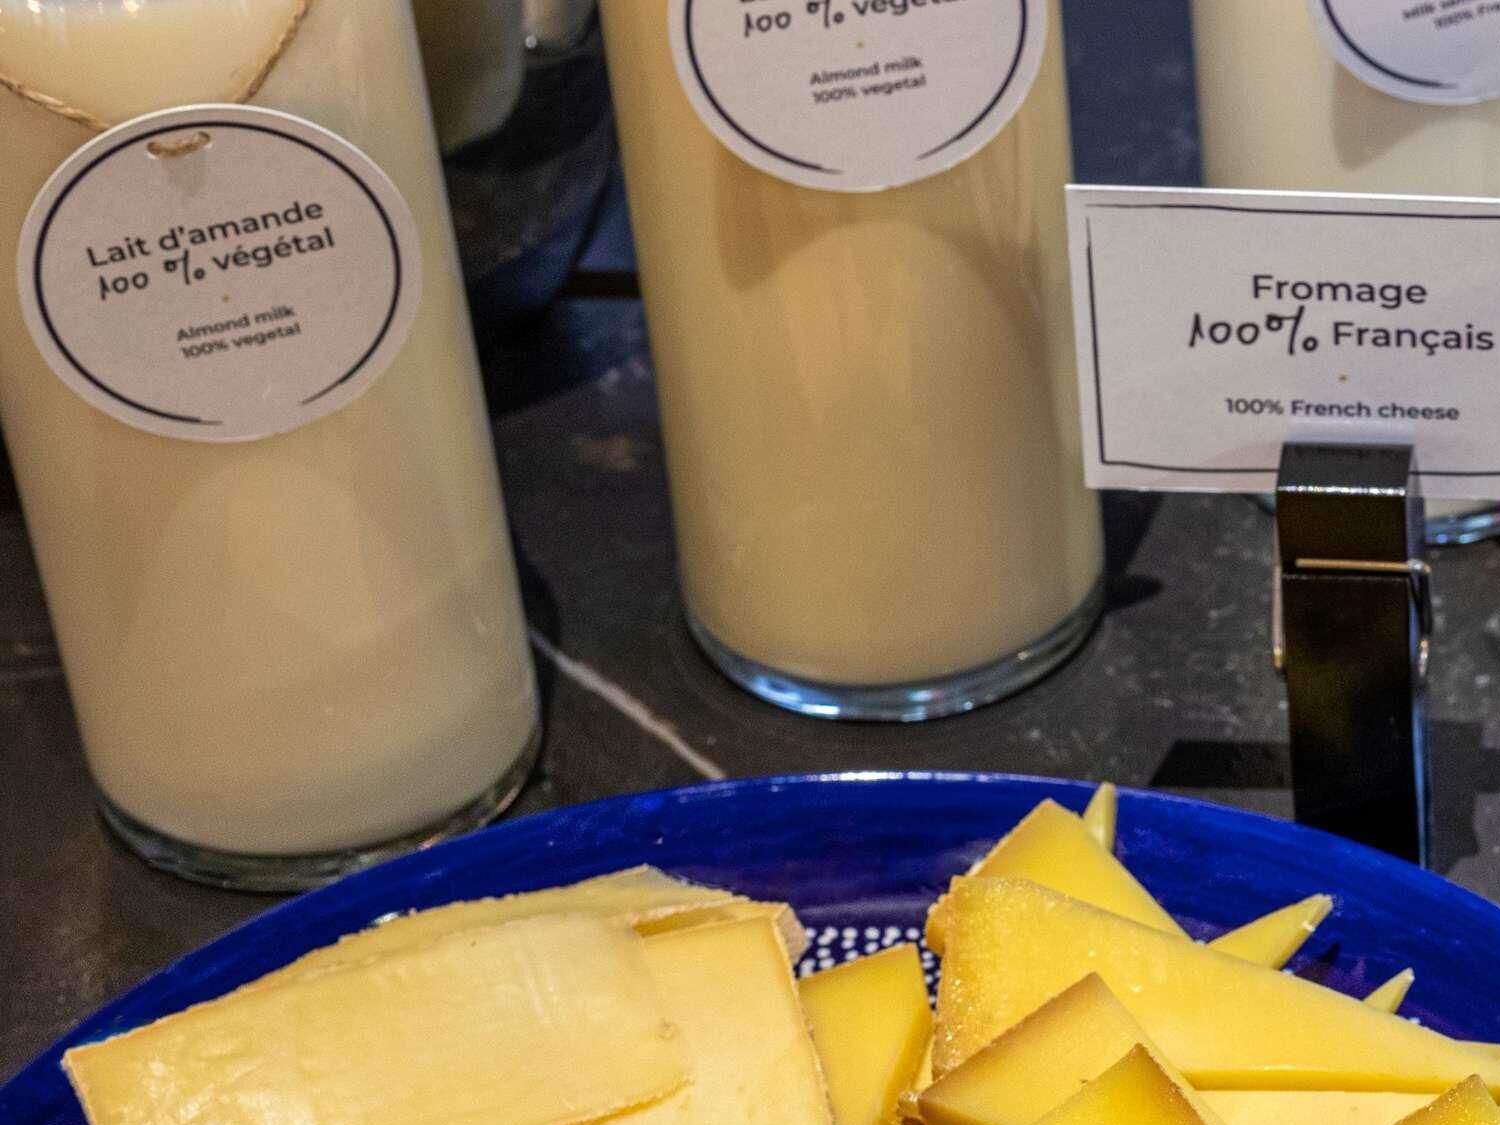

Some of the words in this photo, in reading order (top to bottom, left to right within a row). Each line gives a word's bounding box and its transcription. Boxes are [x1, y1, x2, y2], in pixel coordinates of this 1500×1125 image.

[744, 12, 792, 38] 100
[810, 63, 881, 85] Almond
[884, 56, 923, 72] milk
[813, 86, 857, 103] 100%
[861, 74, 926, 95] vegetal
[87, 227, 150, 267] Lait
[158, 201, 324, 251] d'amande
[99, 270, 150, 301] 100
[212, 226, 335, 269] végétal
[1252, 274, 1428, 310] Fromage
[177, 312, 250, 341] Almond
[254, 305, 295, 323] milk
[181, 340, 229, 359] 100%
[231, 321, 301, 346] vegetal
[1188, 305, 1319, 356] 100%
[1333, 321, 1495, 356] Français
[1225, 396, 1285, 417] 100%
[1291, 399, 1372, 419] French
[1377, 402, 1460, 421] cheese
